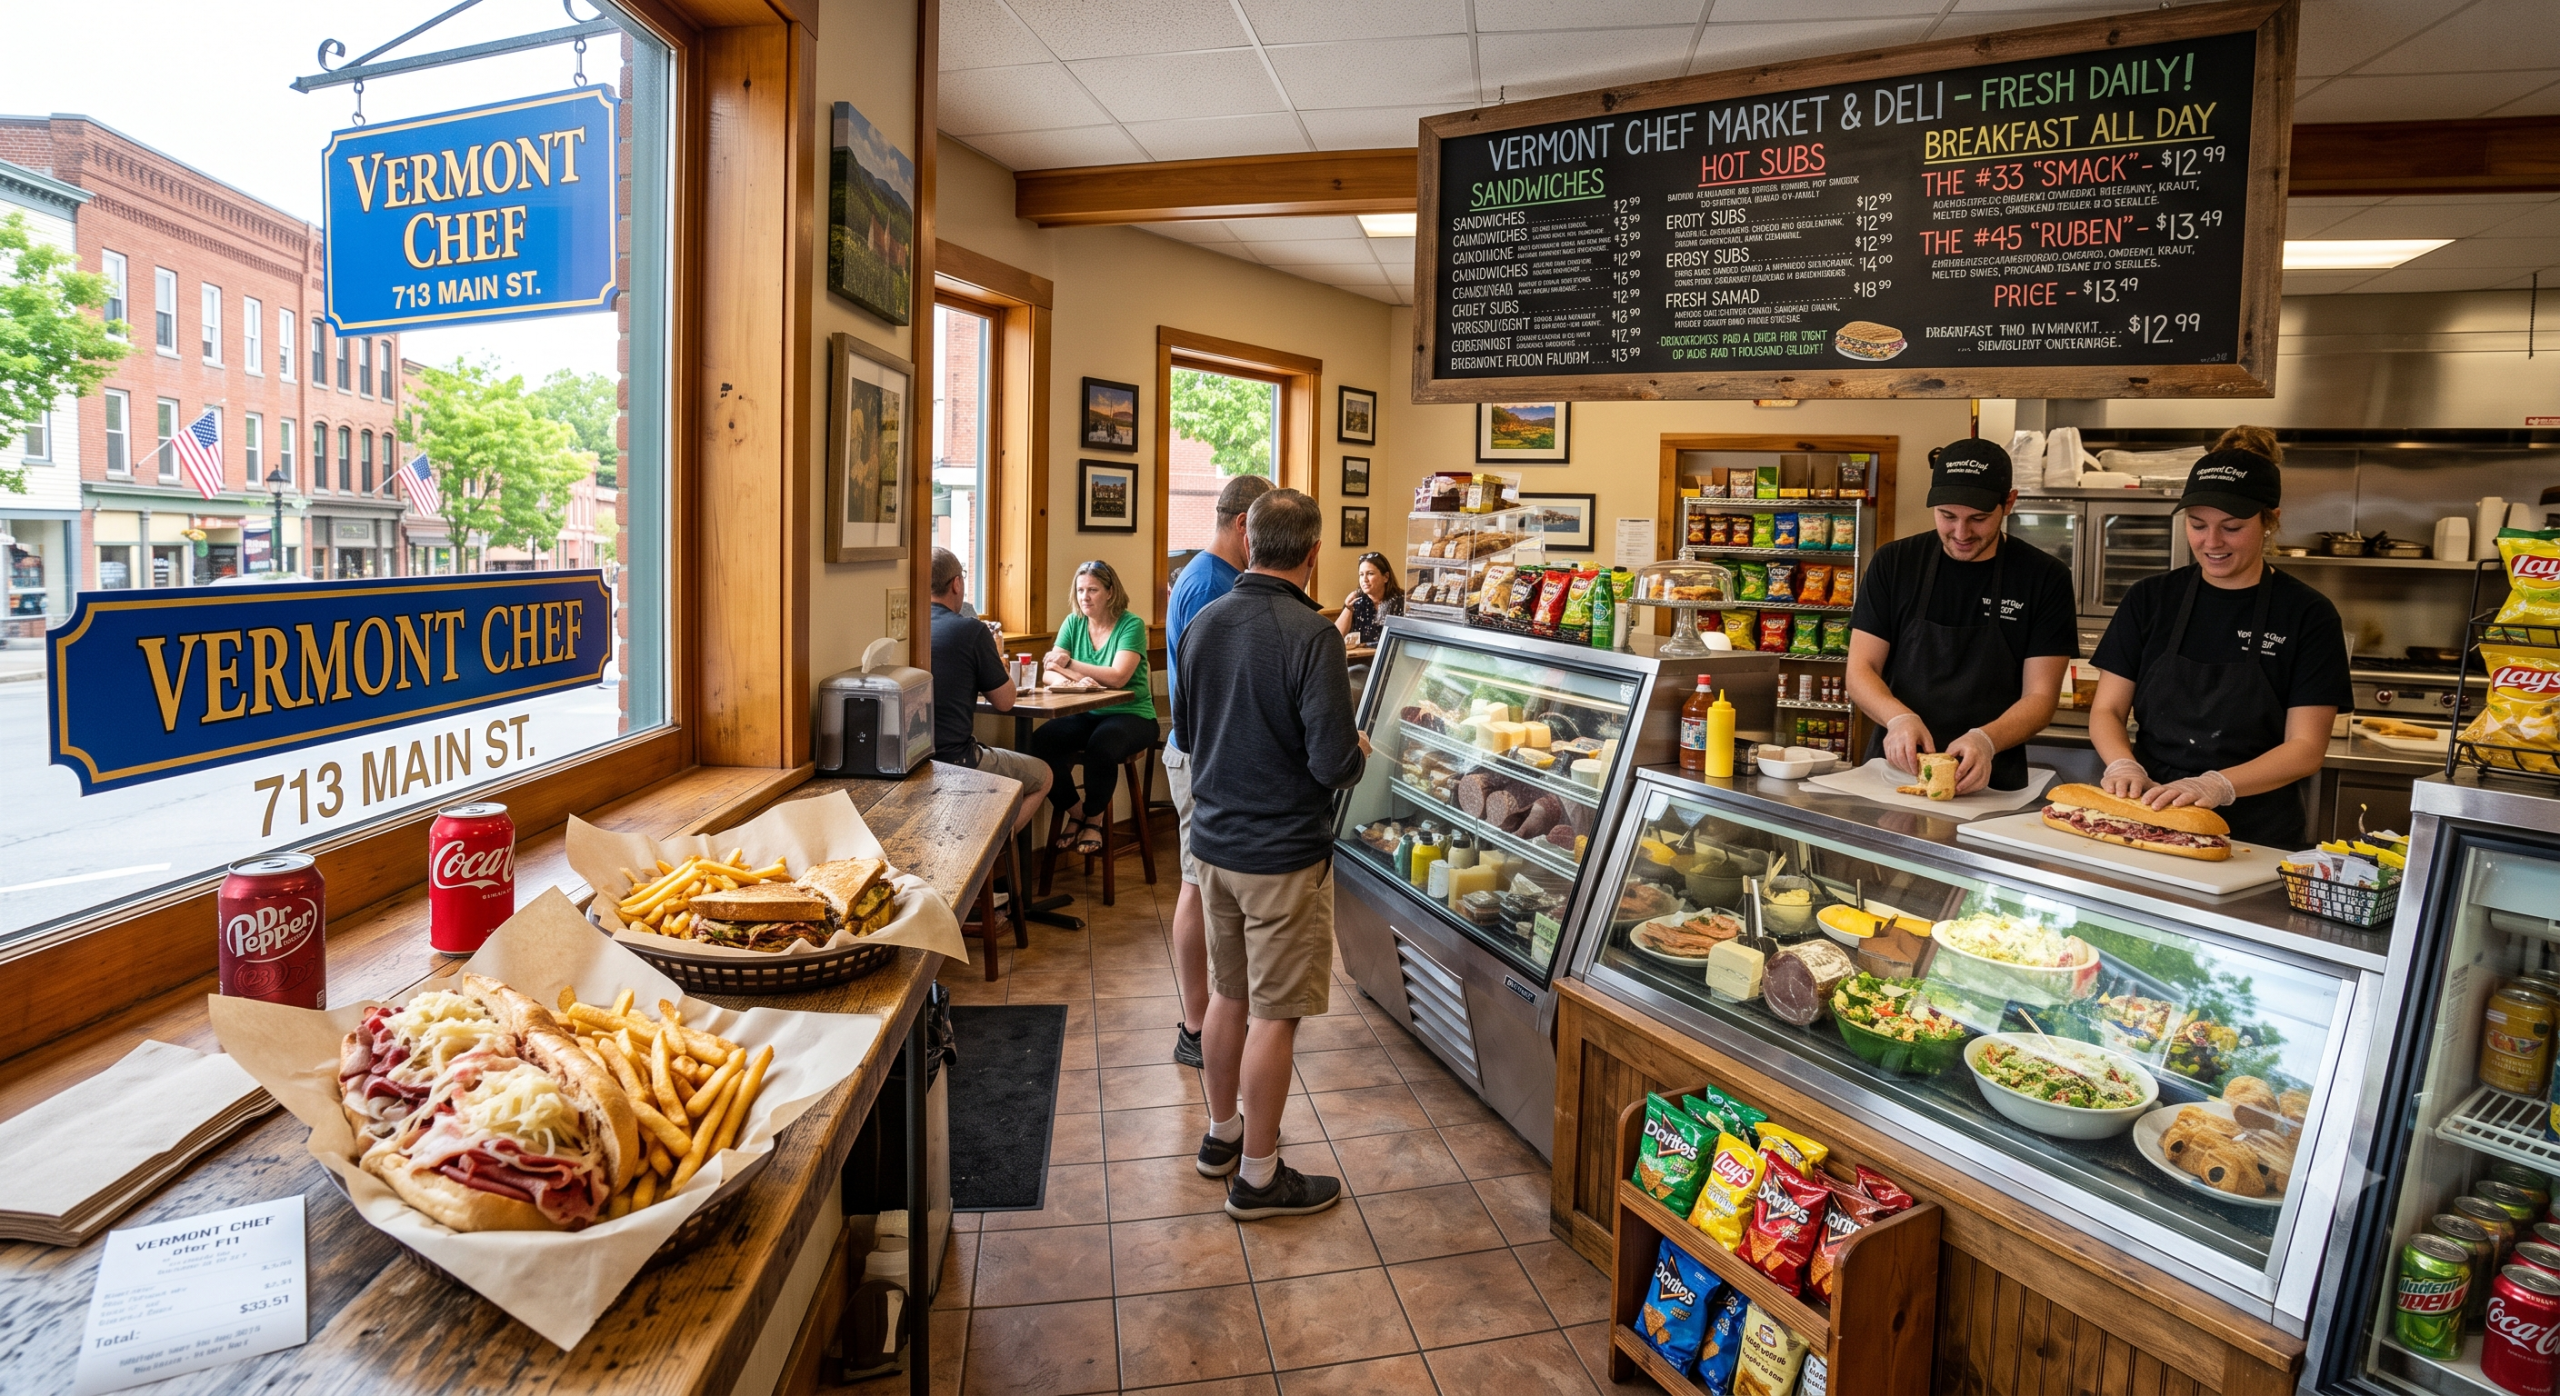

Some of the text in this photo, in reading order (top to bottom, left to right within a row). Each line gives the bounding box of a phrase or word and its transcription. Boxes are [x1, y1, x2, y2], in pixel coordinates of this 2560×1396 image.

[1488, 122, 1616, 171] VERMONT
[1624, 111, 1698, 155] CHEF
[1707, 94, 1830, 146] MARKET
[1840, 92, 1863, 131] &
[1874, 80, 1943, 127] DELI
[1981, 68, 2075, 112] FRESH
[2088, 52, 2195, 100] DAILY!
[1924, 101, 2218, 160] BREAKFAST ALL DAY
[346, 124, 585, 213] VERMONT
[1701, 142, 1827, 183] HOT SUBS
[1470, 167, 1606, 208] SANDWICHES
[1921, 169, 1966, 198] THE
[1975, 163, 2025, 191] #33
[2158, 180, 2200, 193] KRAUT,
[1452, 210, 1526, 232] SANDWICHES
[1665, 212, 1706, 231] EROTY
[1710, 207, 1747, 226] SUBS
[1932, 209, 1968, 220] MELTED
[403, 204, 527, 269] CHEF
[1919, 228, 1965, 257] THE
[1972, 224, 2023, 251] #45
[2155, 209, 2224, 242] $13.49
[1713, 246, 1750, 265] SUBS
[2157, 244, 2196, 256] KRAUT,
[1931, 268, 1967, 280] MELTED
[391, 270, 542, 310] 713 MAIN ST.
[1665, 291, 1707, 309] FRESH
[1711, 287, 1761, 306] SAMAD
[1993, 282, 2059, 308] PRICE
[2082, 277, 2139, 304] $13.49
[1489, 299, 1520, 315] SUBS
[2127, 313, 2202, 345] $12.99
[2513, 554, 2560, 582] Lay
[136, 598, 584, 735] VERMONT CHEF
[253, 713, 537, 839] 713 MAIN ST.
[227, 907, 313, 958] Pepper
[255, 904, 293, 934] Dr
[135, 1215, 276, 1252] VERMONT CHEF
[239, 1294, 290, 1315] $33.51
[94, 1329, 142, 1349] Total:
